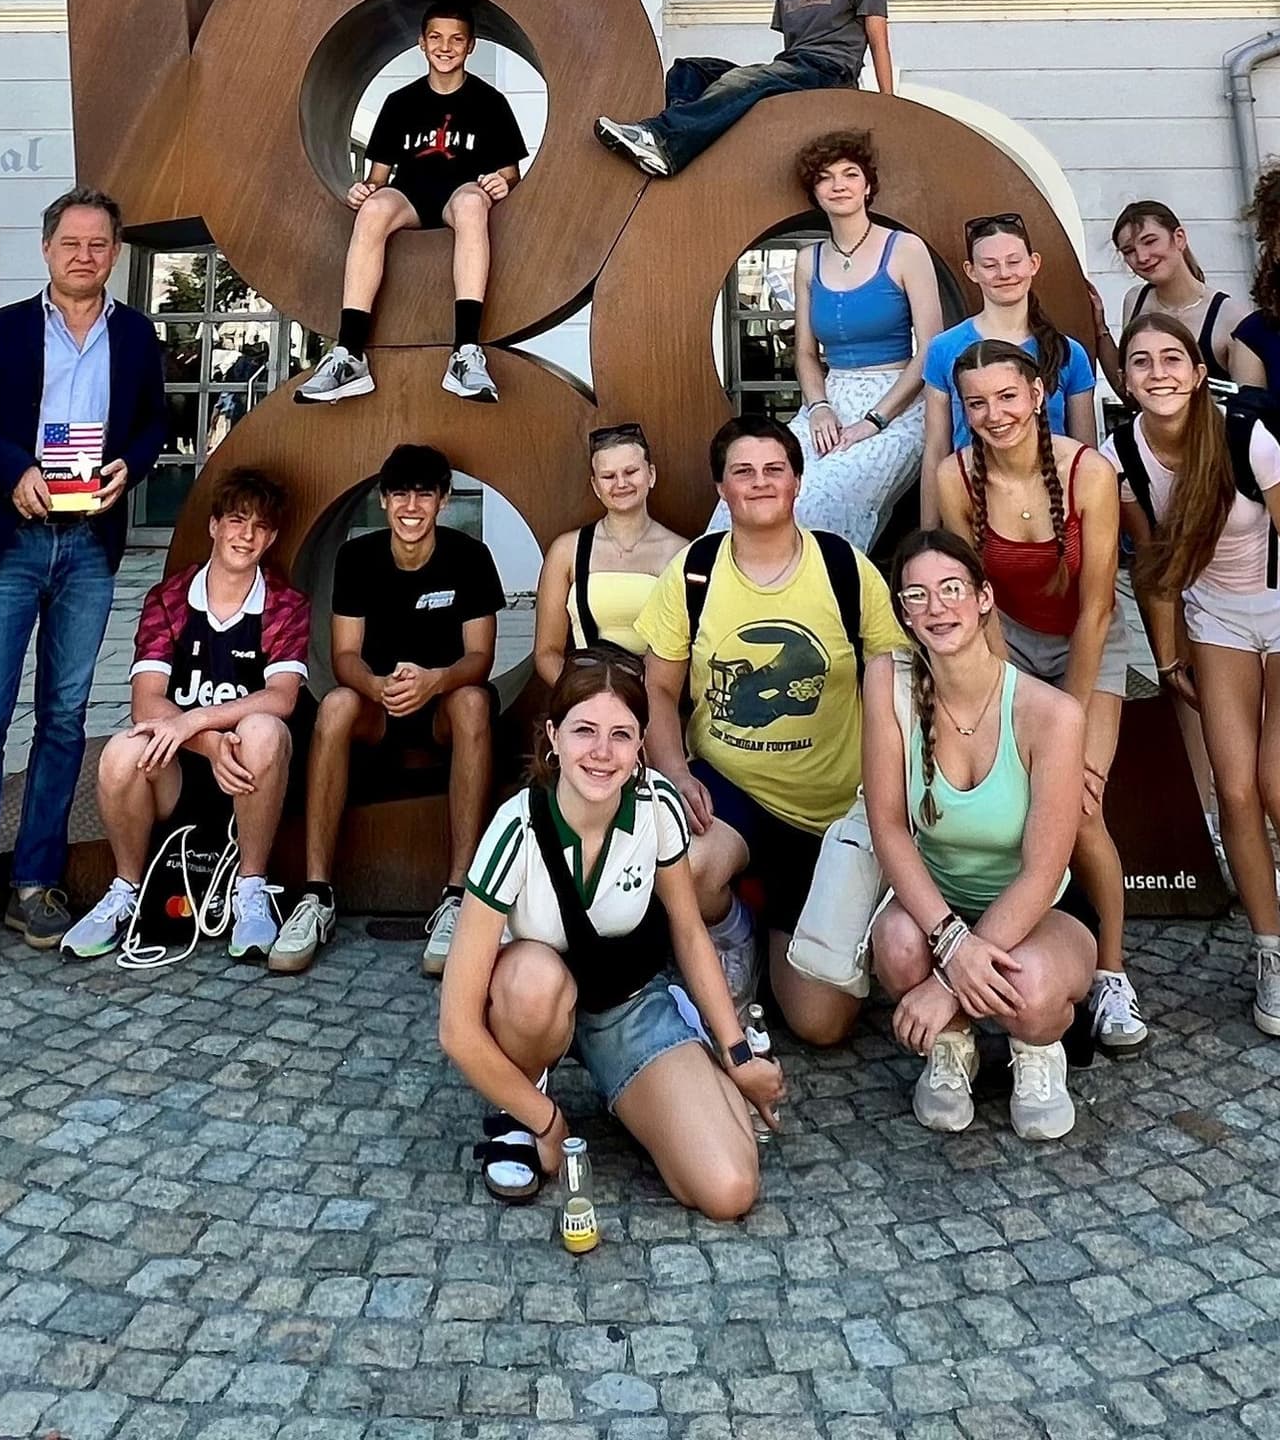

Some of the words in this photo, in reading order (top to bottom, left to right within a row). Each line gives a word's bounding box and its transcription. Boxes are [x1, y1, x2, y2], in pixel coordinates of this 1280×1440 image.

[174, 669, 249, 708] Jee
[766, 737, 813, 752] FOOTBALL
[1124, 870, 1197, 890] usen.de
